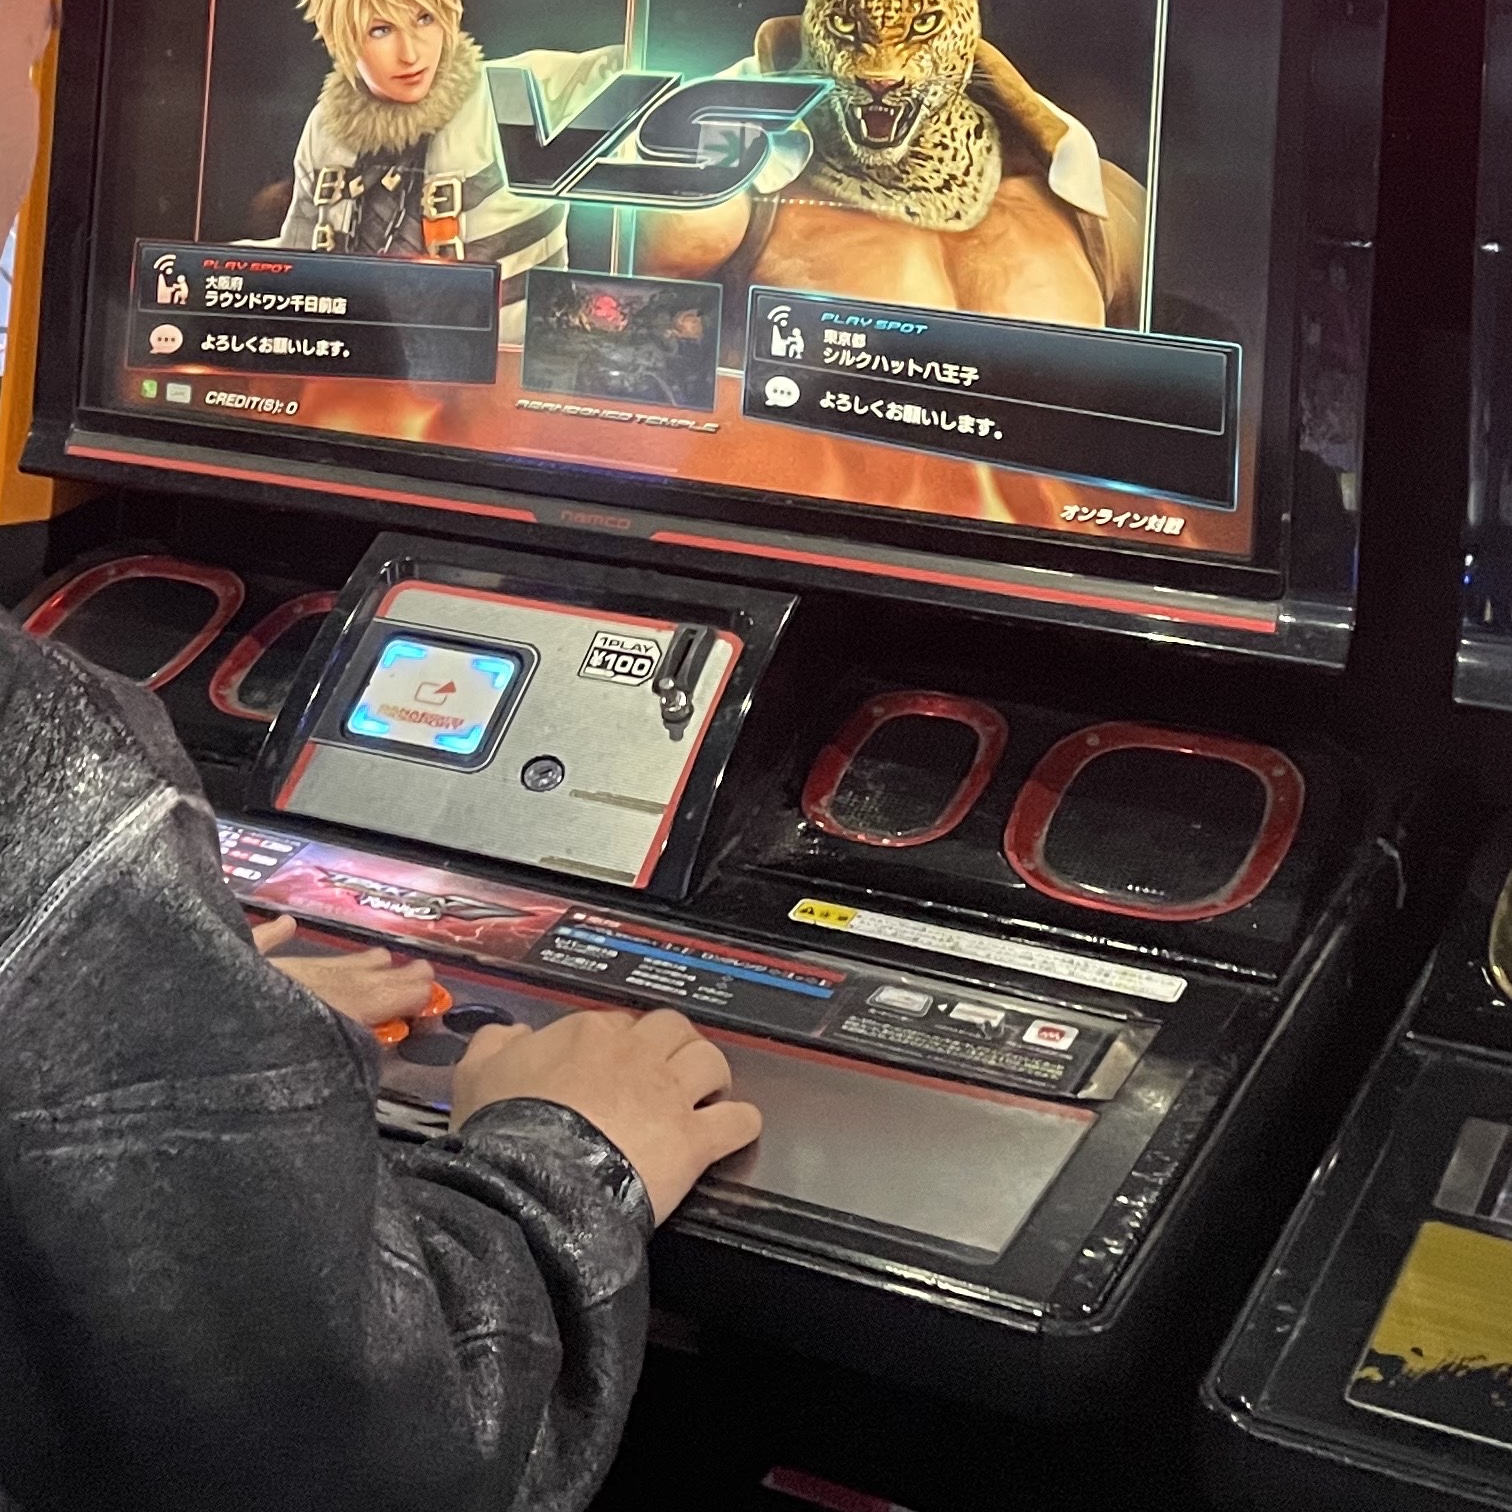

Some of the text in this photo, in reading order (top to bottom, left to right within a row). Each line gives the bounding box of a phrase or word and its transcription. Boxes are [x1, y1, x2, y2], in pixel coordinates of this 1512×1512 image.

[203, 259, 294, 274] PLAY SPOT
[821, 311, 929, 335] PLAY SPOT
